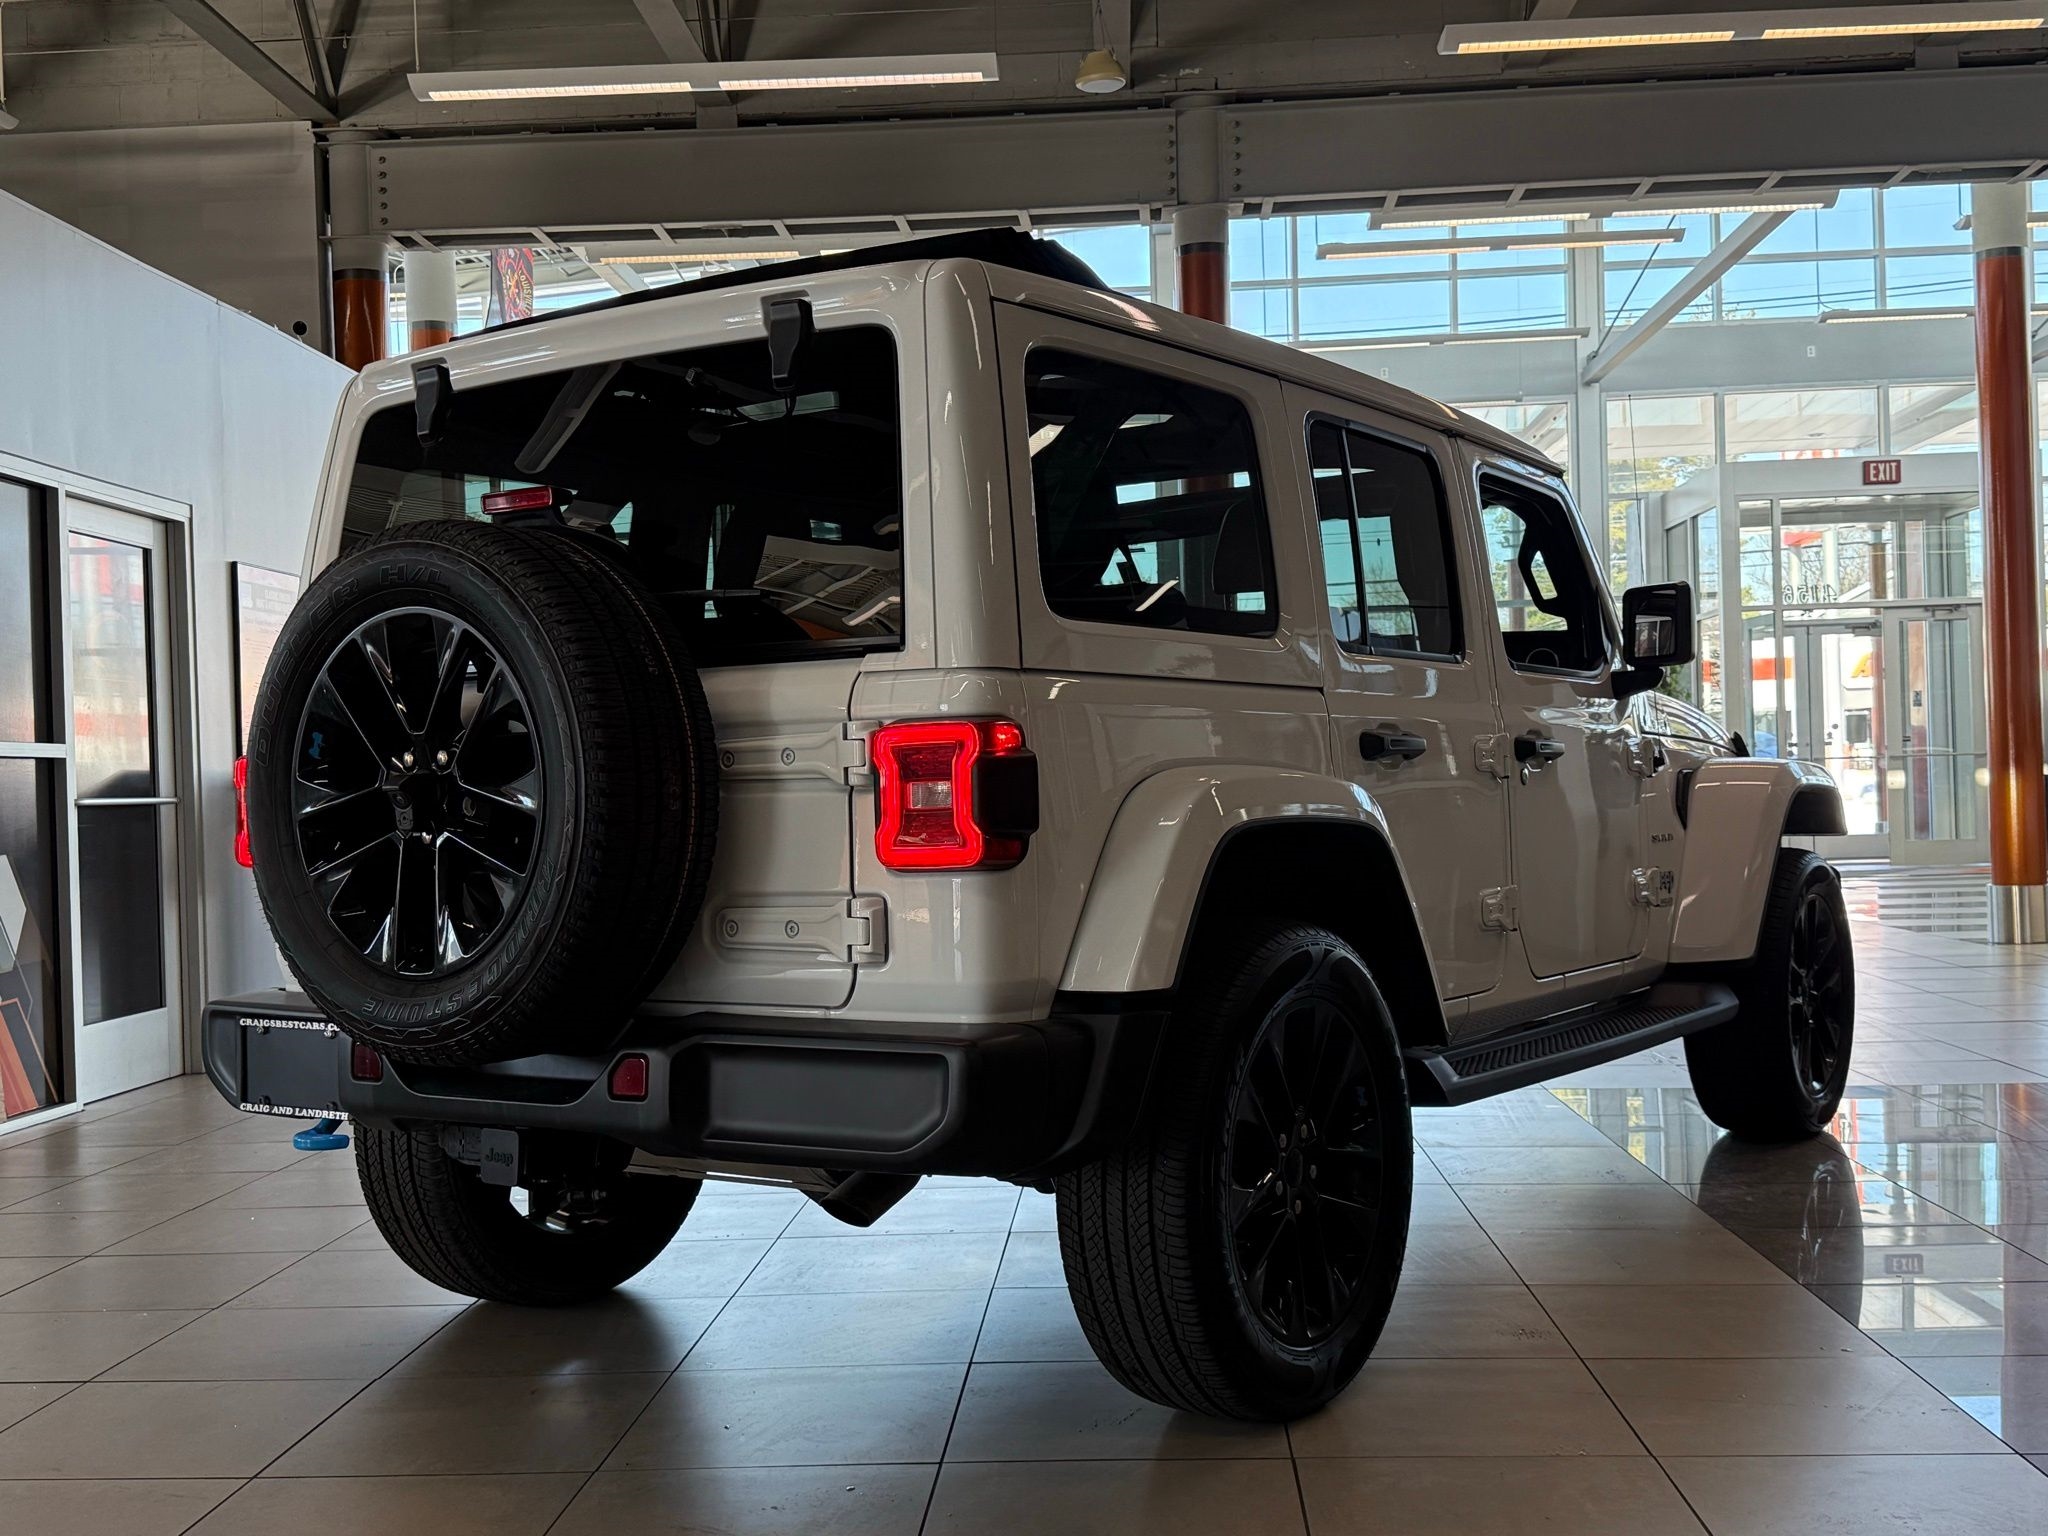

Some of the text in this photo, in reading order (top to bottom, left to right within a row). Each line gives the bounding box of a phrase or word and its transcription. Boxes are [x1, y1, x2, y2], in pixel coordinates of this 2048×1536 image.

[1870, 462, 1897, 481] EXIT
[255, 563, 450, 767] DUELER H/L
[362, 856, 555, 1023] BRIDGESTONE
[239, 1102, 349, 1121] CRAIG AND LANDRETH
